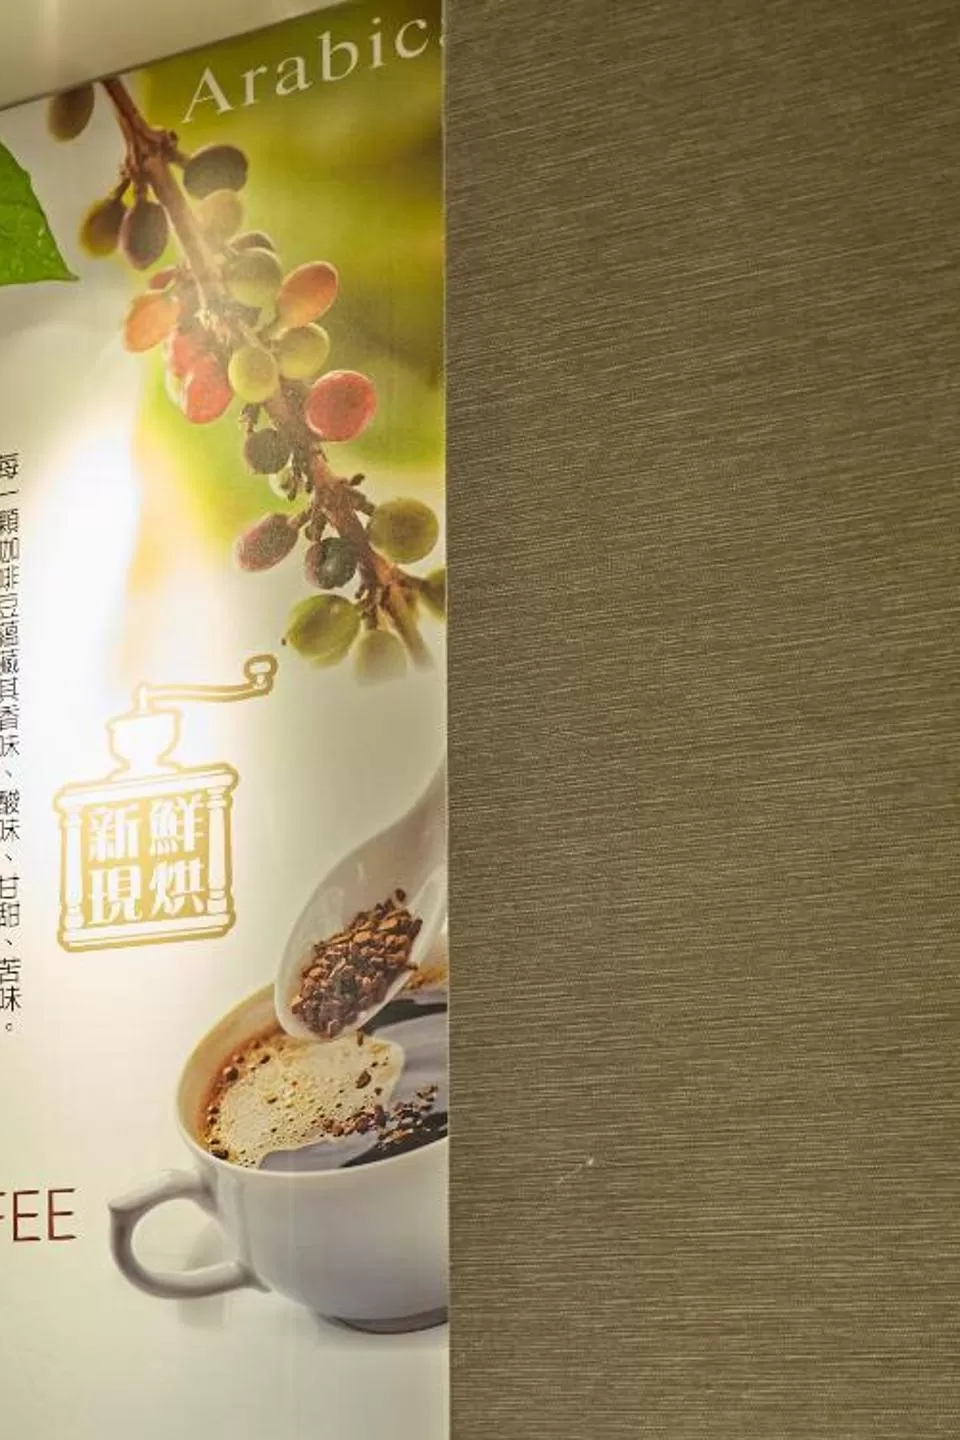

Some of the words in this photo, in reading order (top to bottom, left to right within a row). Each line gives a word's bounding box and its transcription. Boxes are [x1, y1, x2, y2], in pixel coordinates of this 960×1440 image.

[180, 16, 444, 124] Arabic
[87, 794, 205, 862] 新鮮
[87, 857, 206, 925] 現烘
